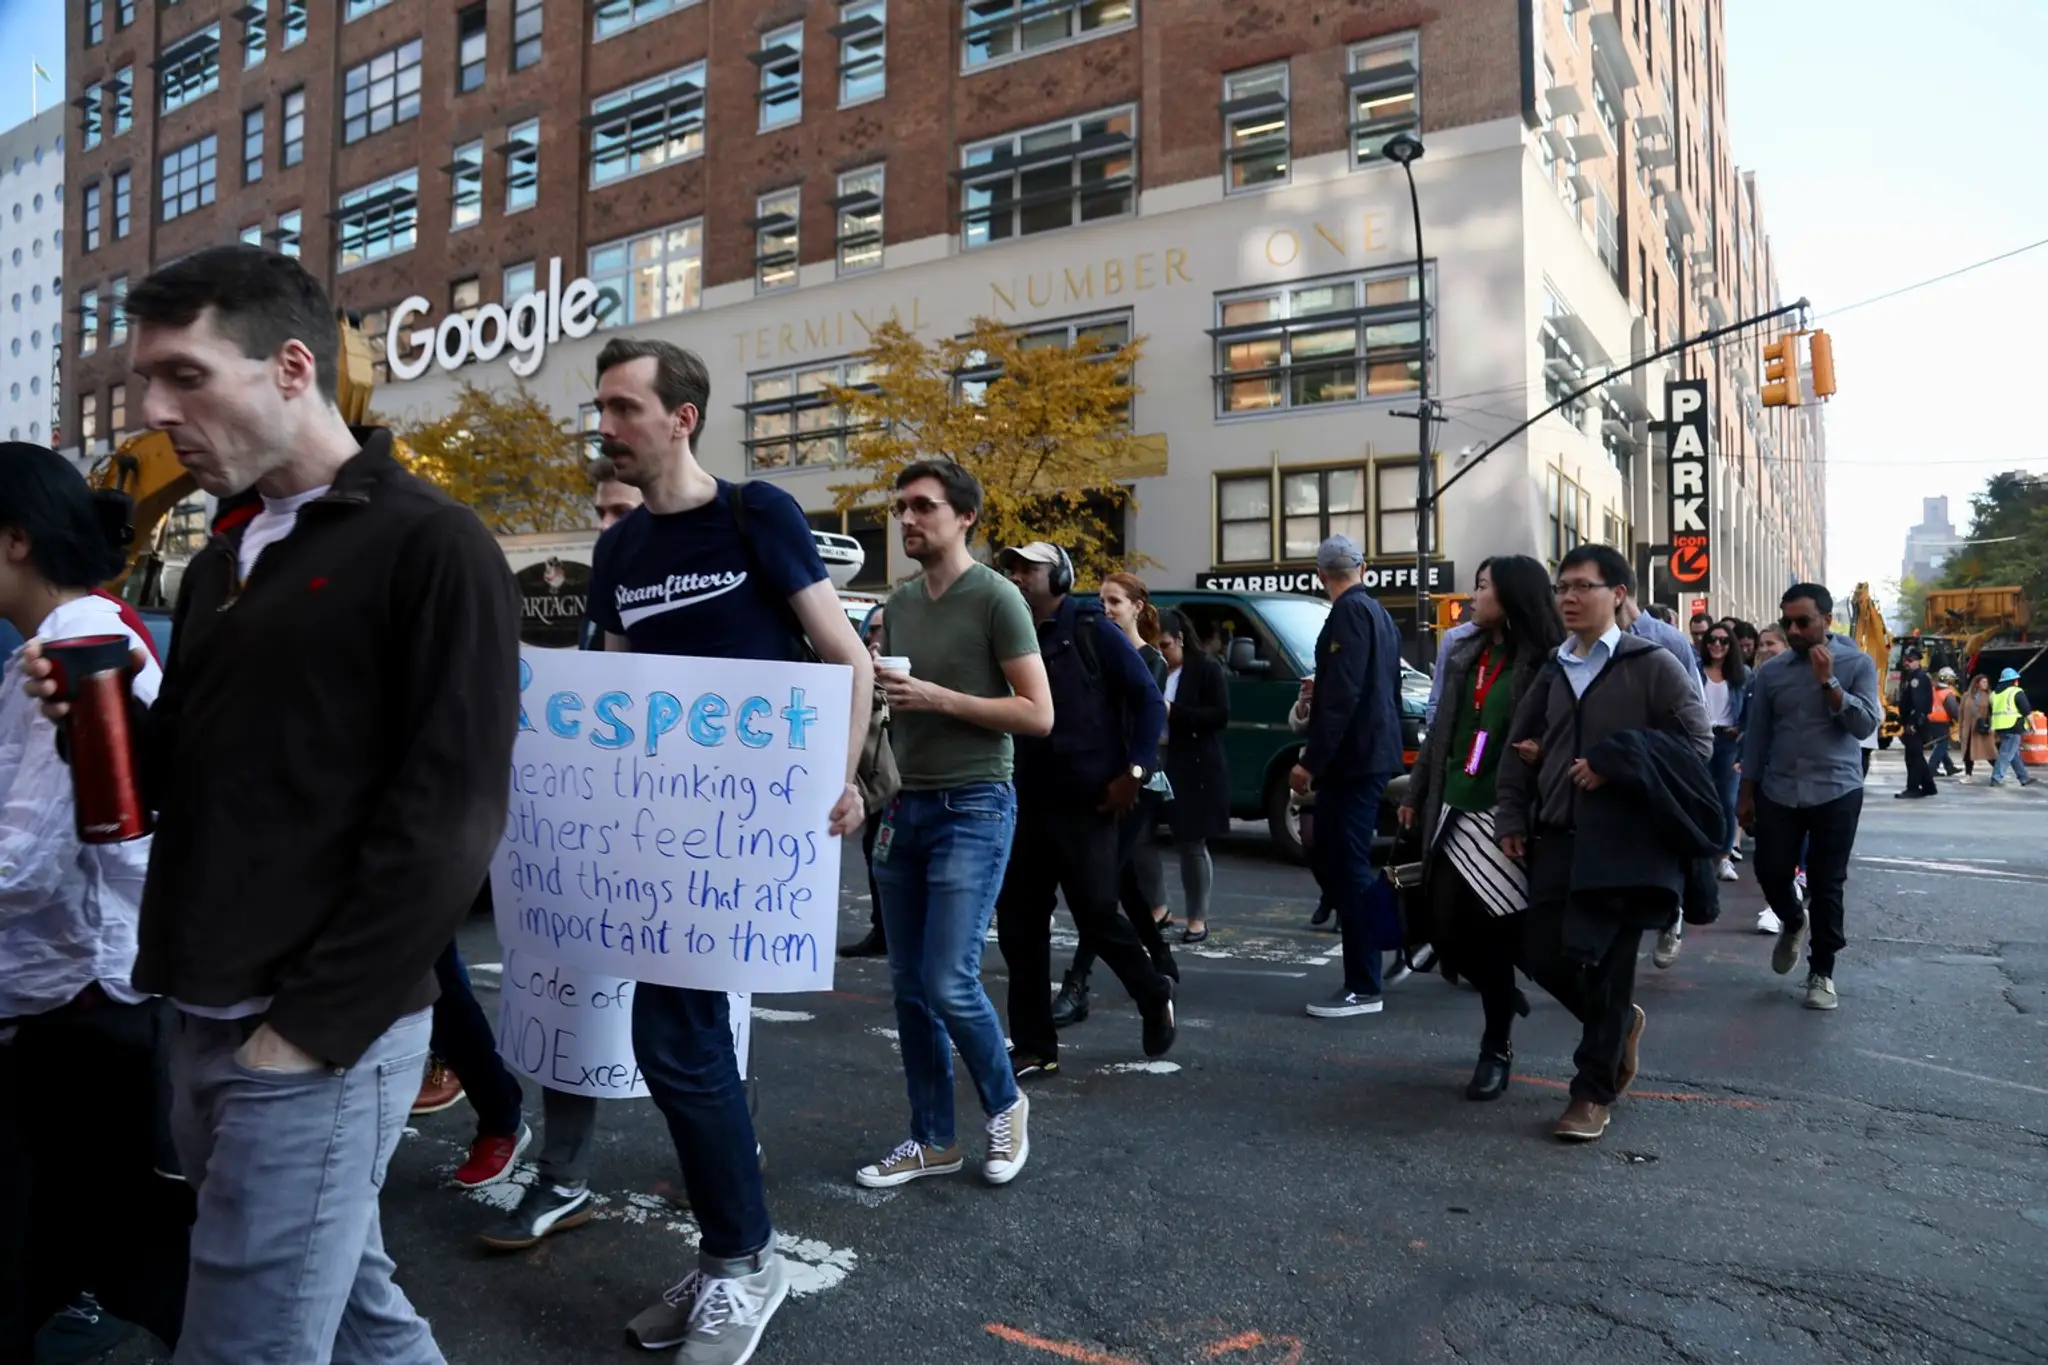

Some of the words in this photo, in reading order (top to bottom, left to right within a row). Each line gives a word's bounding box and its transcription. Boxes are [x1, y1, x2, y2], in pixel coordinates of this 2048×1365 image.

[387, 256, 599, 380] Google
[732, 297, 930, 362] TERMINAL
[990, 247, 1193, 314] NUMBER
[1265, 212, 1389, 266] ONE
[1671, 388, 1706, 532] PARK
[1672, 534, 1707, 547] icon
[520, 595, 587, 625] ARTAGN
[615, 571, 746, 610] Steamfitters
[1206, 573, 1325, 592] STARBUCK
[1363, 568, 1439, 588] OFFEE
[614, 757, 757, 820] thinking
[769, 764, 808, 804] of
[632, 807, 817, 882] feelings
[508, 850, 563, 895] and
[577, 861, 673, 921] things
[688, 870, 747, 912] that
[755, 882, 812, 920] are
[518, 898, 673, 955] important
[685, 922, 715, 954] to
[729, 920, 817, 972] them
[508, 949, 580, 1007] Code
[591, 981, 631, 1009] of
[500, 1000, 547, 1073] NO
[551, 1028, 645, 1092] Excep
